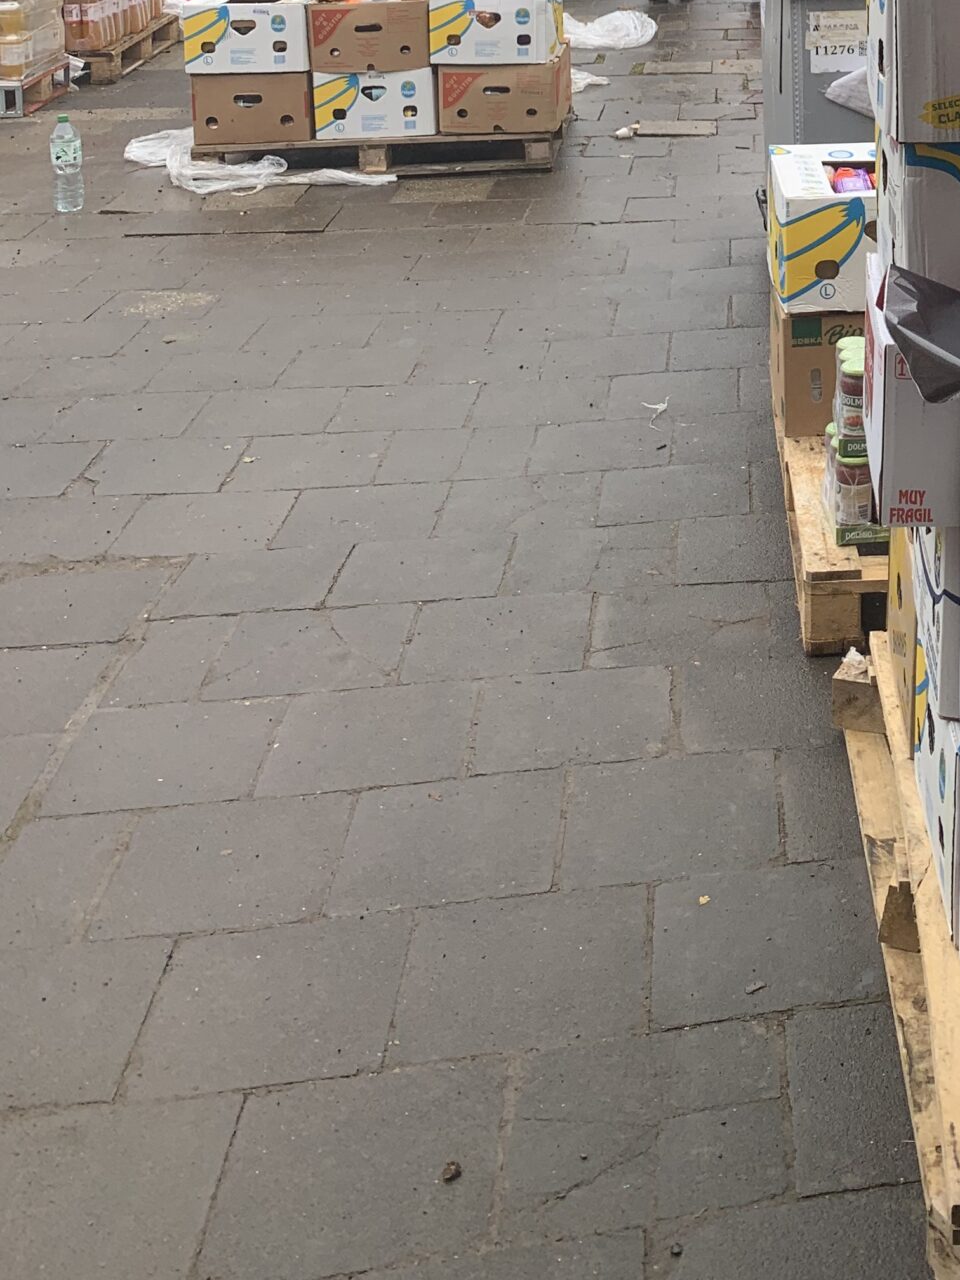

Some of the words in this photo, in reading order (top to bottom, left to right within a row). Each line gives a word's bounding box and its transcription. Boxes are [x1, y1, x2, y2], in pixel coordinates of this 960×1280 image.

[814, 45, 855, 55] T1276
[899, 490, 926, 506] MUY
[889, 507, 933, 524] FRAGIL
